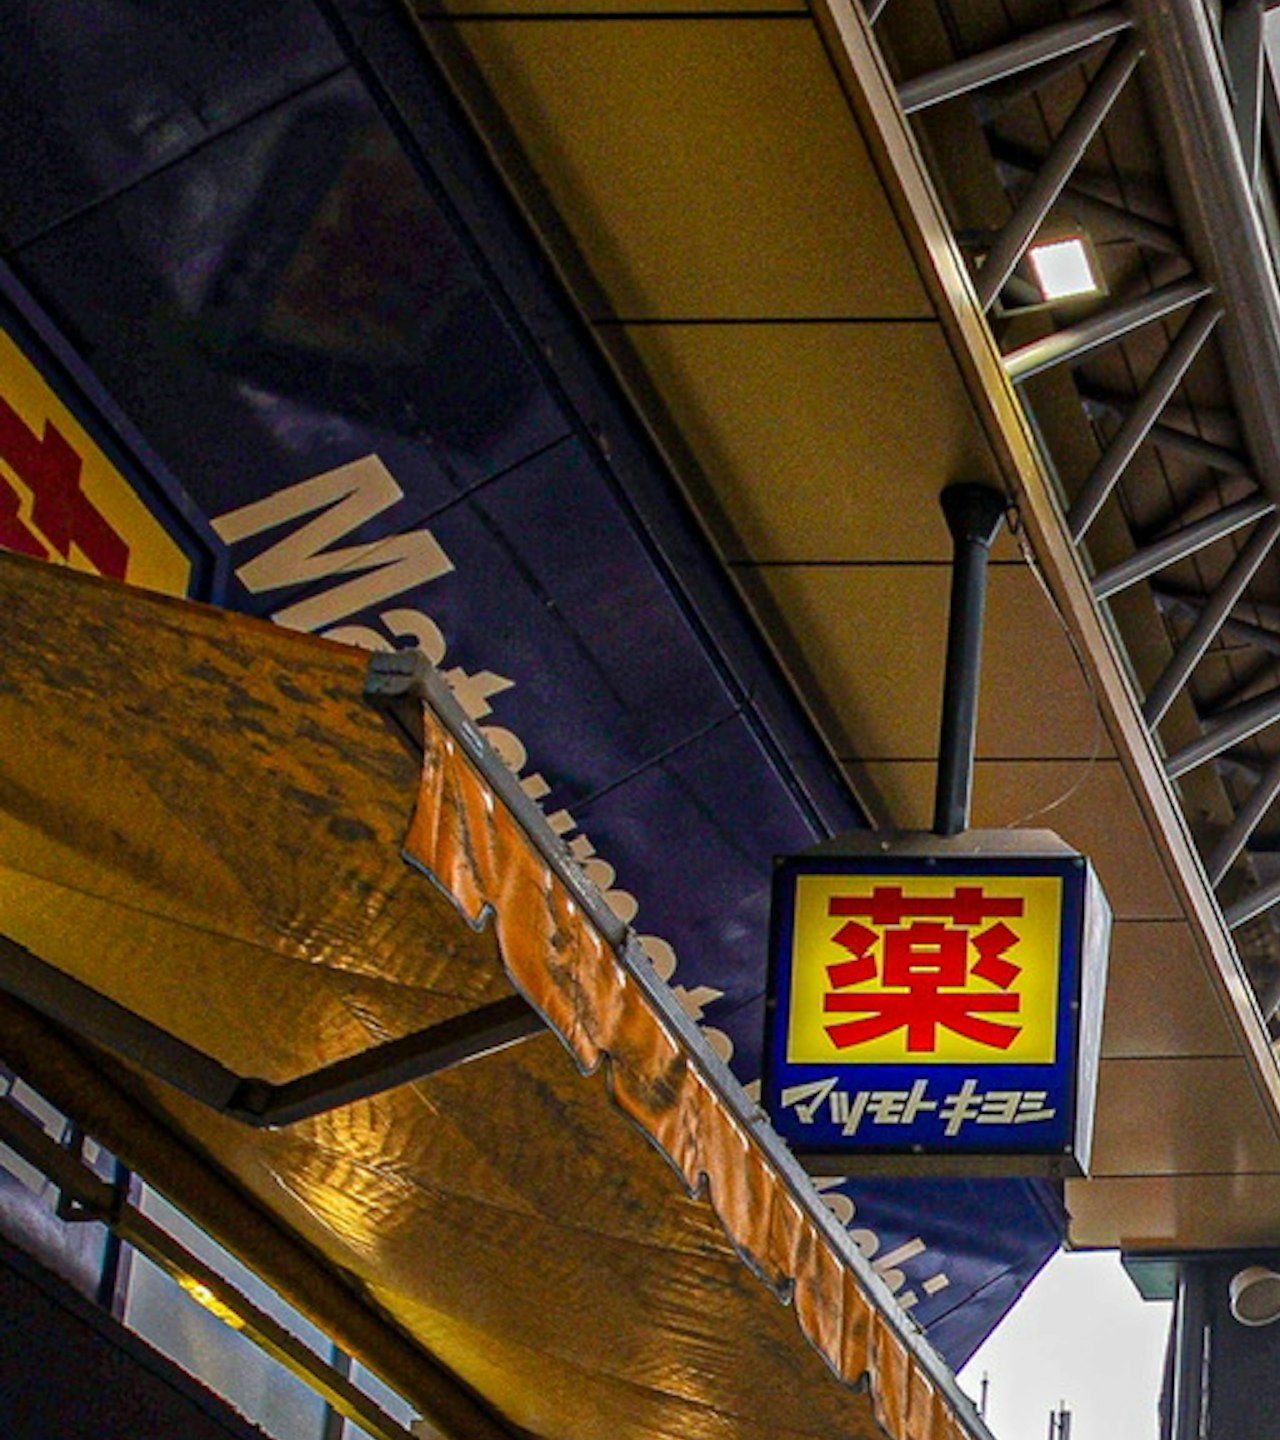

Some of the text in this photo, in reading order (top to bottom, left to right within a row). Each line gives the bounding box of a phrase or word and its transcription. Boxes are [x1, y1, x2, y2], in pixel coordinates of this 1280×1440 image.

[823, 887, 1024, 1053] 薬
[781, 1077, 1056, 1137] マツモトキヨシ
